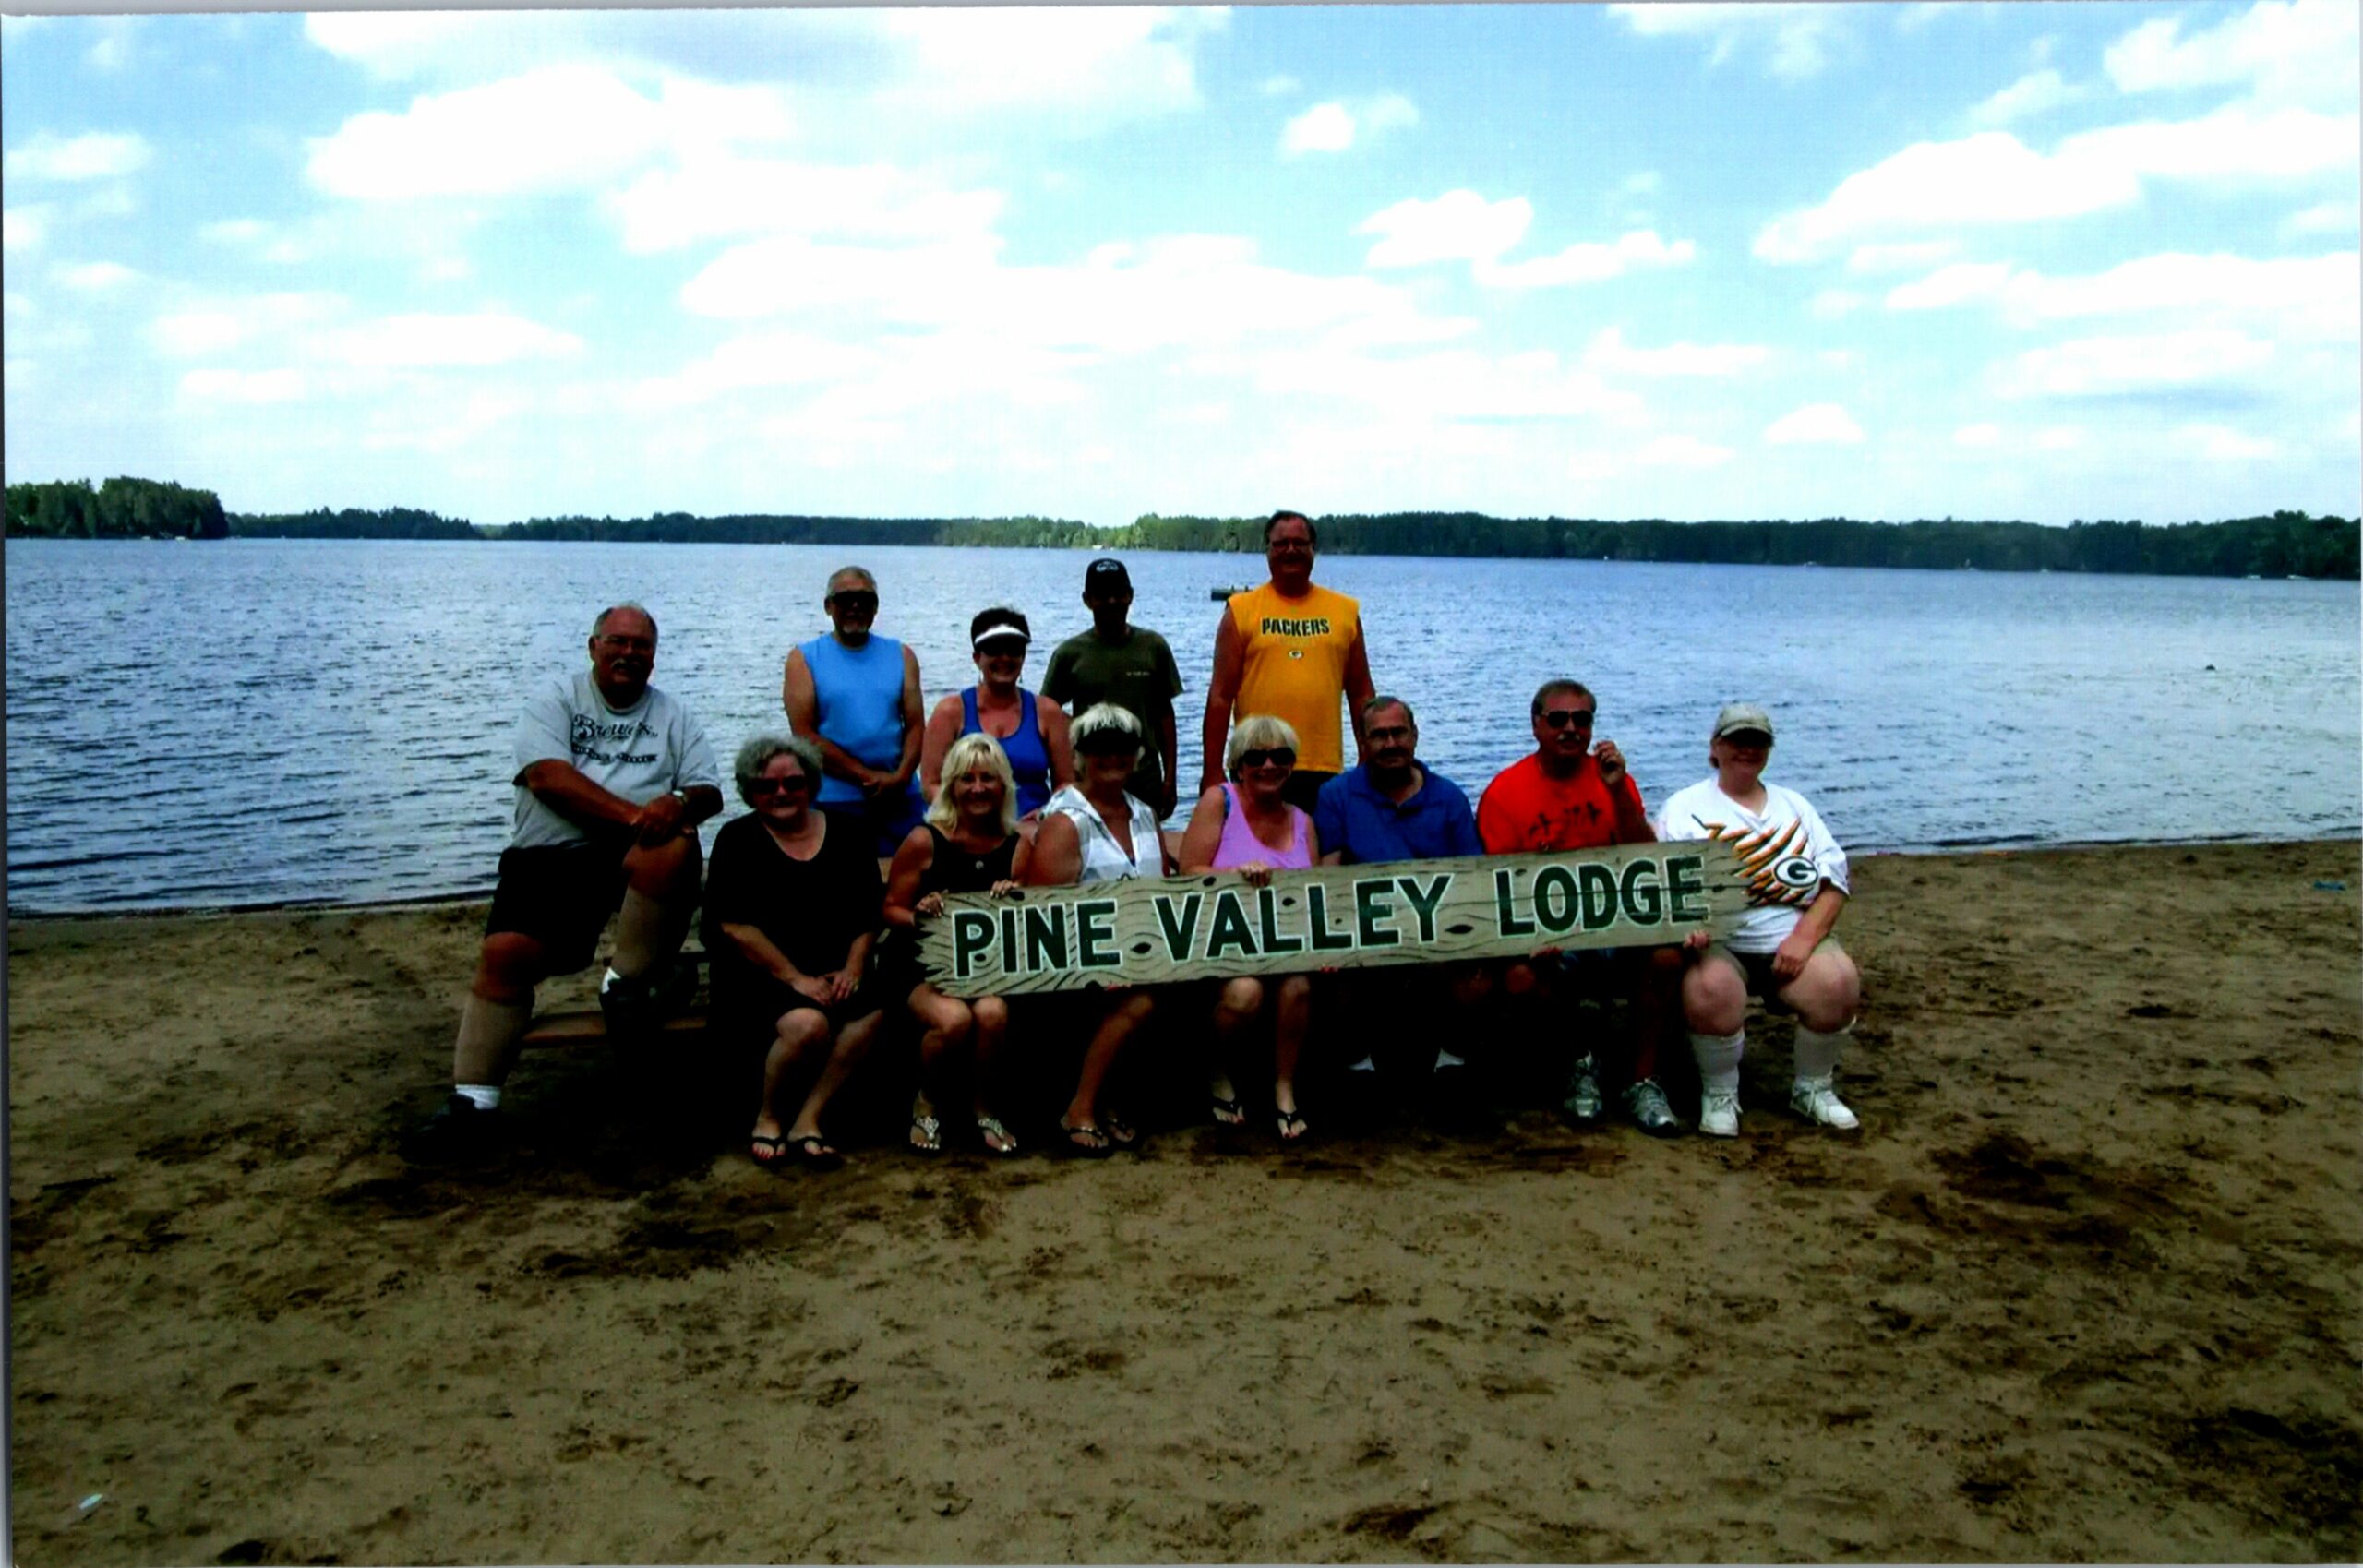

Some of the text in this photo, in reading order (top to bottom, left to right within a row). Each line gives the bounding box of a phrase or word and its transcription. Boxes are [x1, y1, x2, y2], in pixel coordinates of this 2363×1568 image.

[1261, 617, 1331, 638] PACKERS
[1774, 857, 1817, 887] G
[952, 855, 1711, 979] PINE VALLEY LODGE
